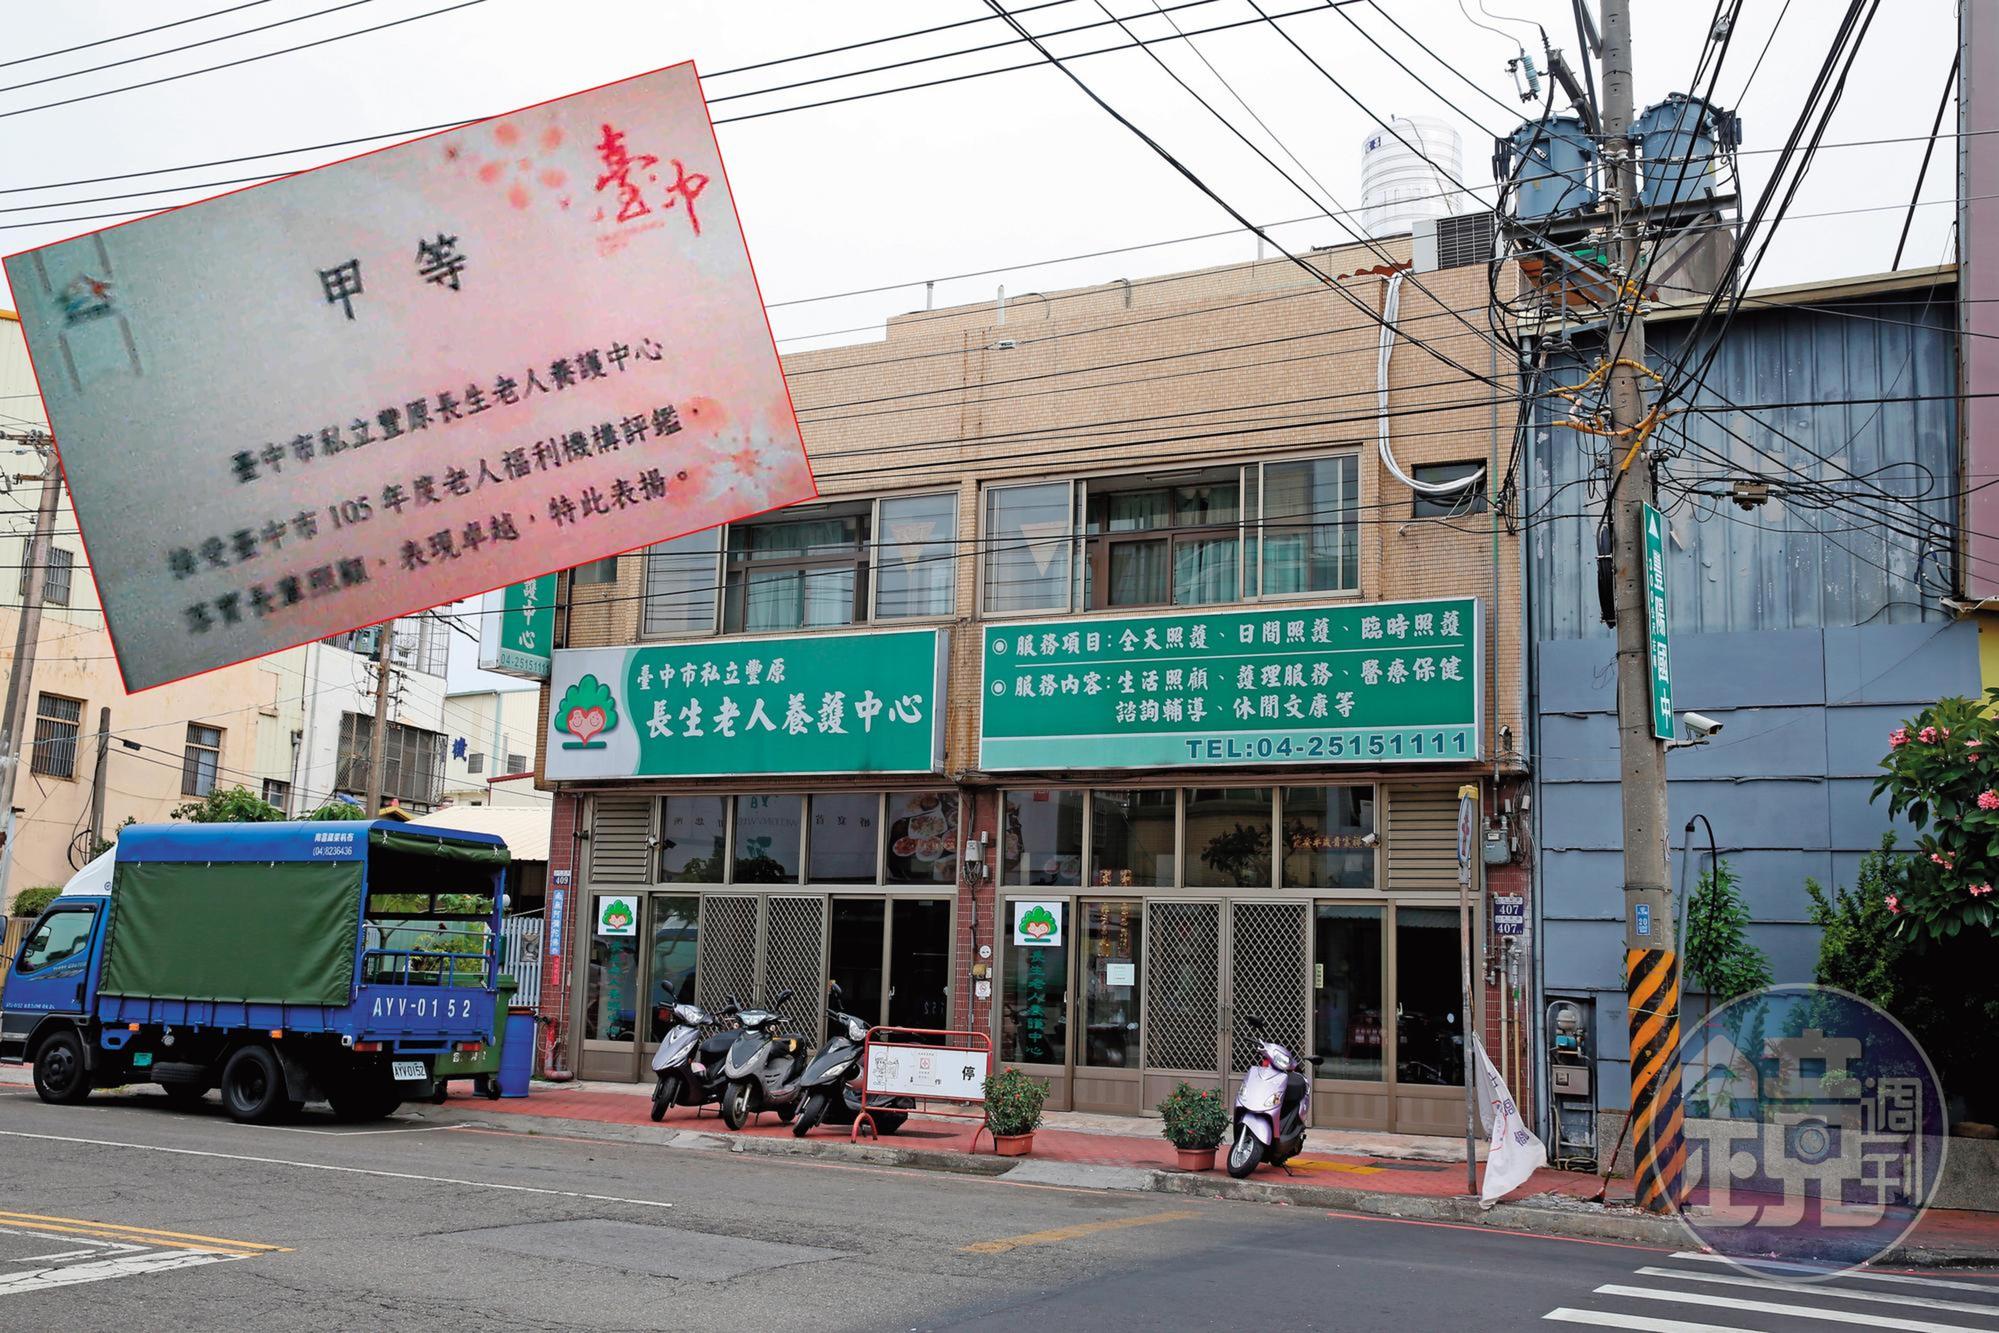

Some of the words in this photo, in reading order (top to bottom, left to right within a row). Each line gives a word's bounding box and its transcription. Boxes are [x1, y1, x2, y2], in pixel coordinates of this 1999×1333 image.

[636, 656, 786, 692] 臺中市私立豐原
[646, 690, 924, 740] 長生老人養護中心
[1185, 731, 1467, 760] TEL:04-25151111
[1499, 904, 1519, 914] 407
[372, 997, 471, 1018] AYV-0152
